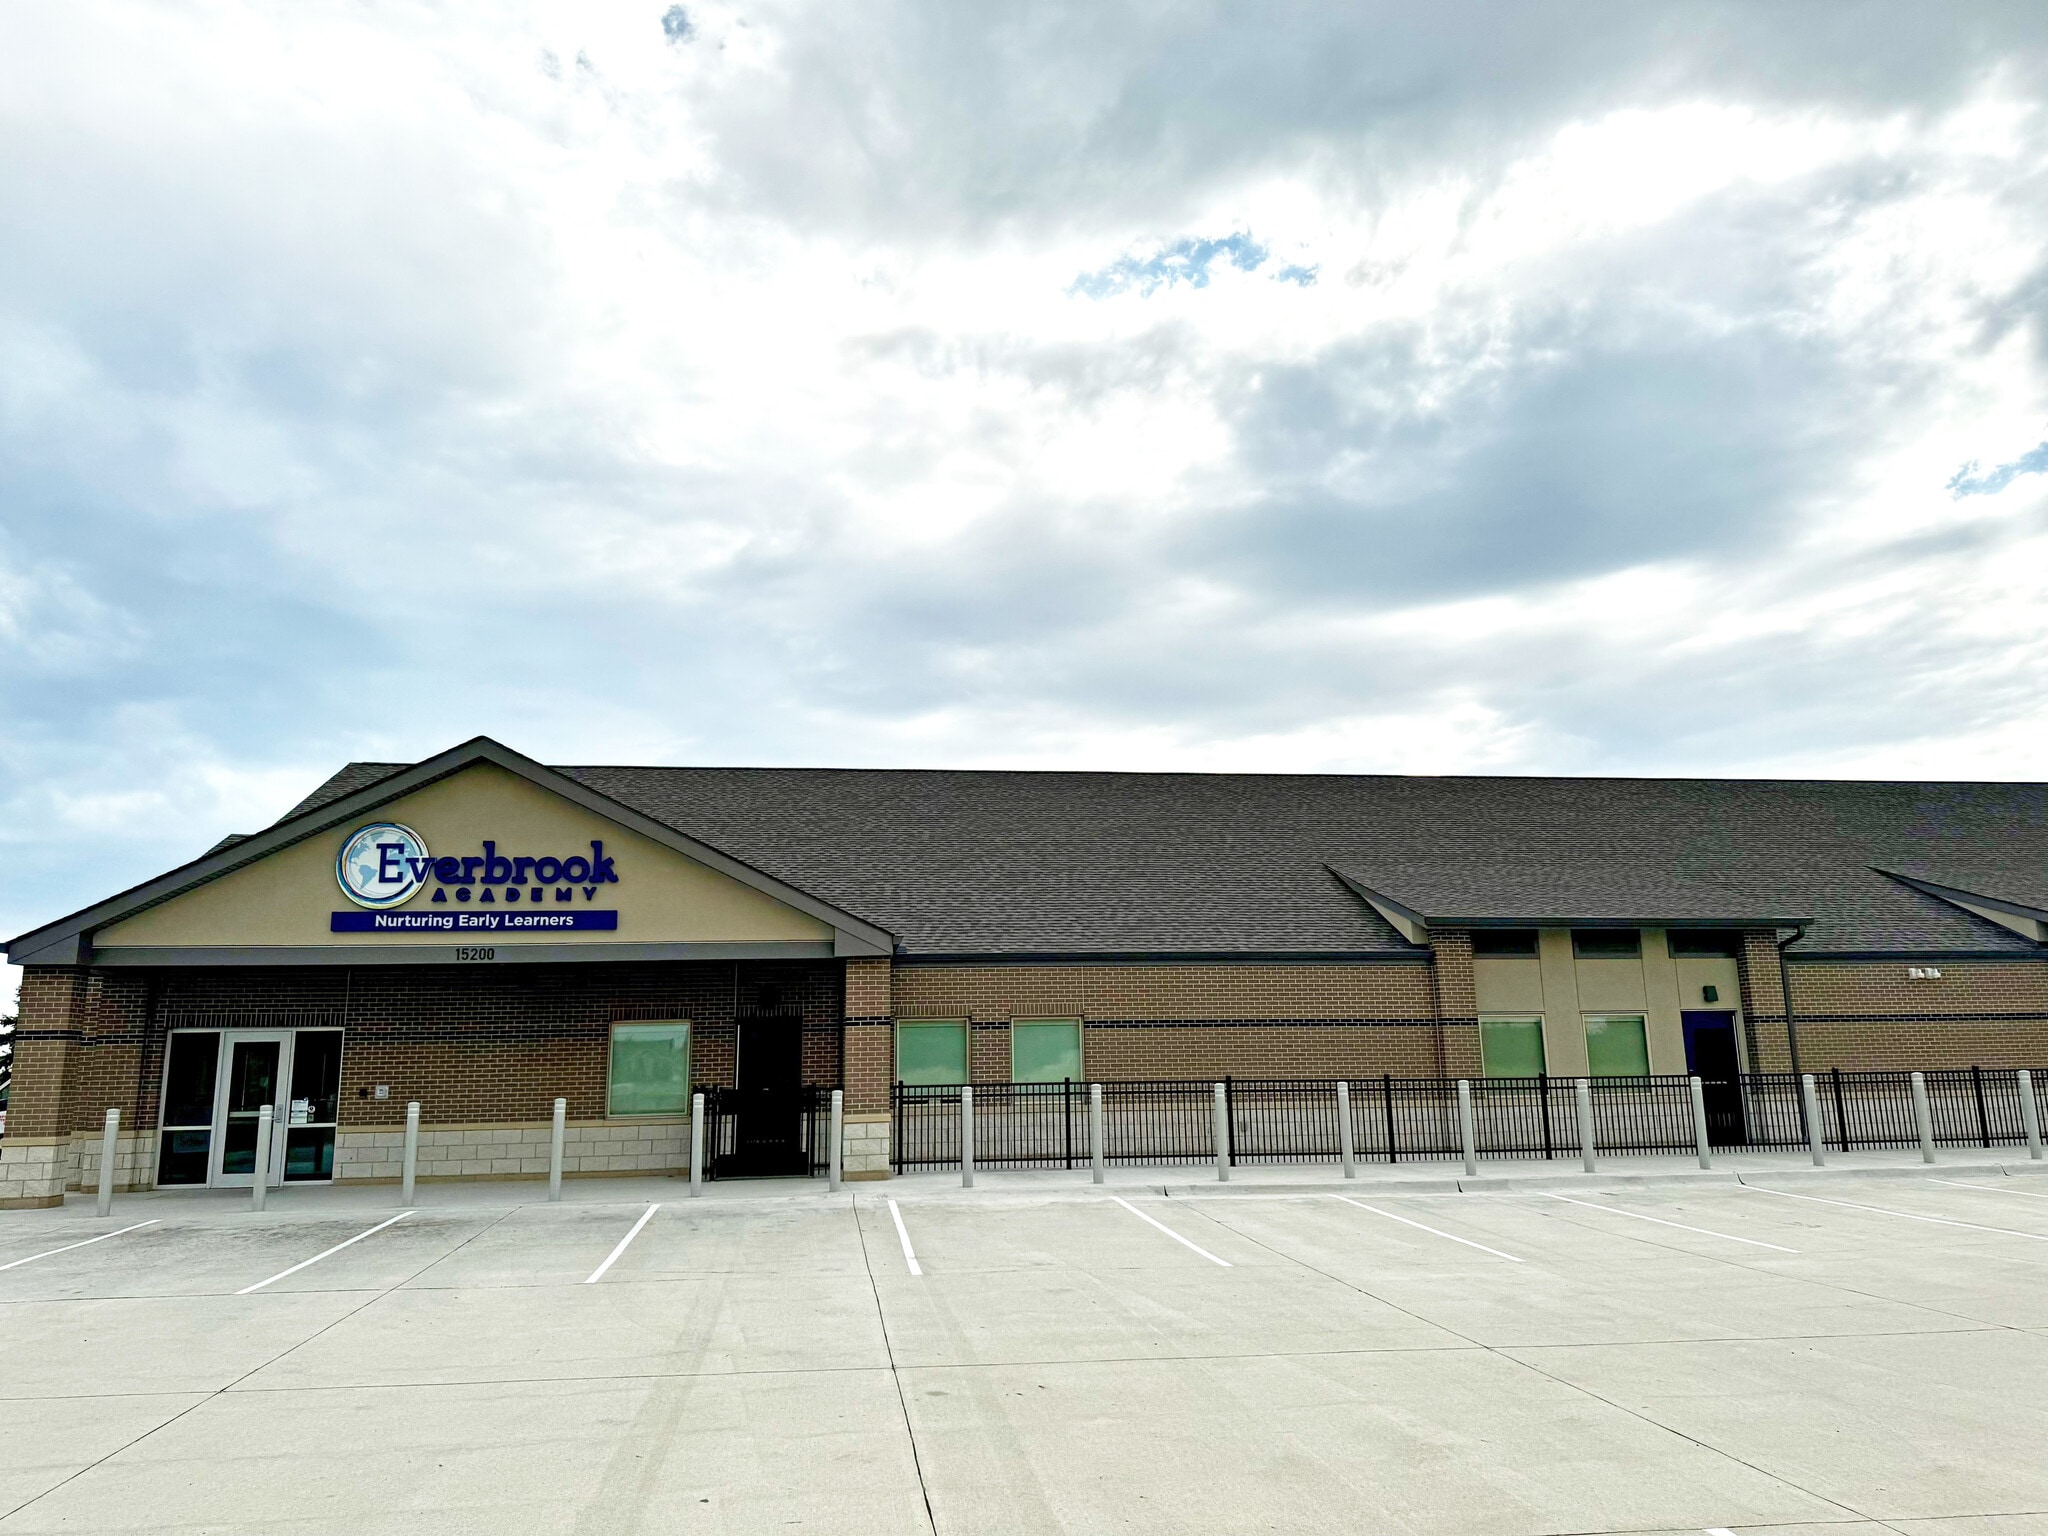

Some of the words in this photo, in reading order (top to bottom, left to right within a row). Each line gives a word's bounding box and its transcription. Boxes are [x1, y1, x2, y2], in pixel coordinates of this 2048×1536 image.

[376, 840, 618, 885] Everbrook
[431, 887, 597, 902] ACADEMY
[375, 914, 453, 929] Nurturing
[458, 914, 499, 929] Early
[504, 913, 574, 927] Learners
[455, 948, 495, 961] 15200
